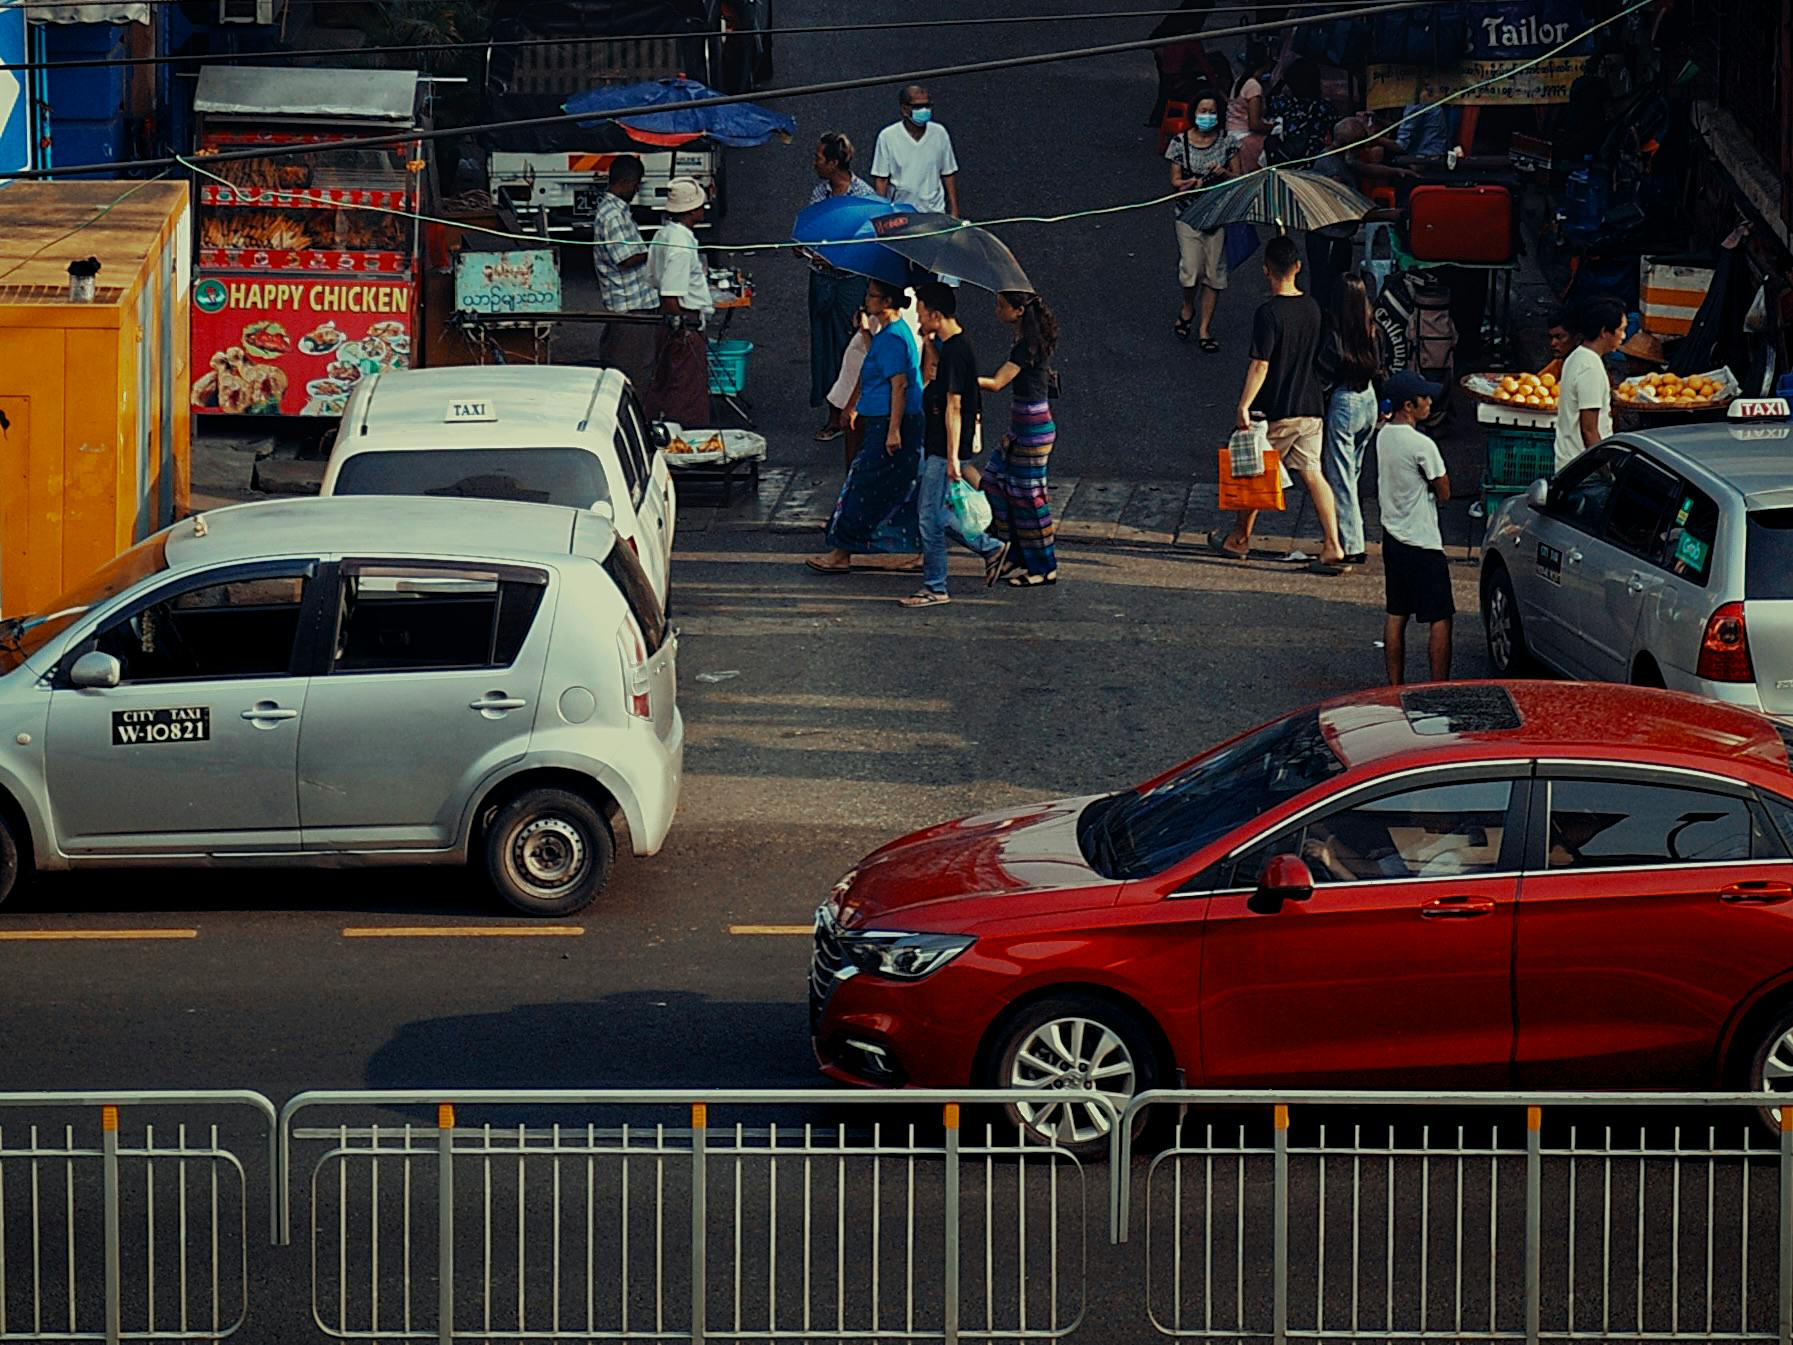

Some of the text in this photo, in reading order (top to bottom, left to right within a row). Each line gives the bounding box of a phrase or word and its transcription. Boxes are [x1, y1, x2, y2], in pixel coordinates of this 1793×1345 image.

[1482, 14, 1571, 47] Tailor
[229, 283, 408, 313] HAPPY CHICKEN
[453, 402, 487, 417] TAXI
[1741, 402, 1786, 417] TAXI
[122, 708, 202, 722] CITY TAXI
[118, 721, 205, 743] W-10821
